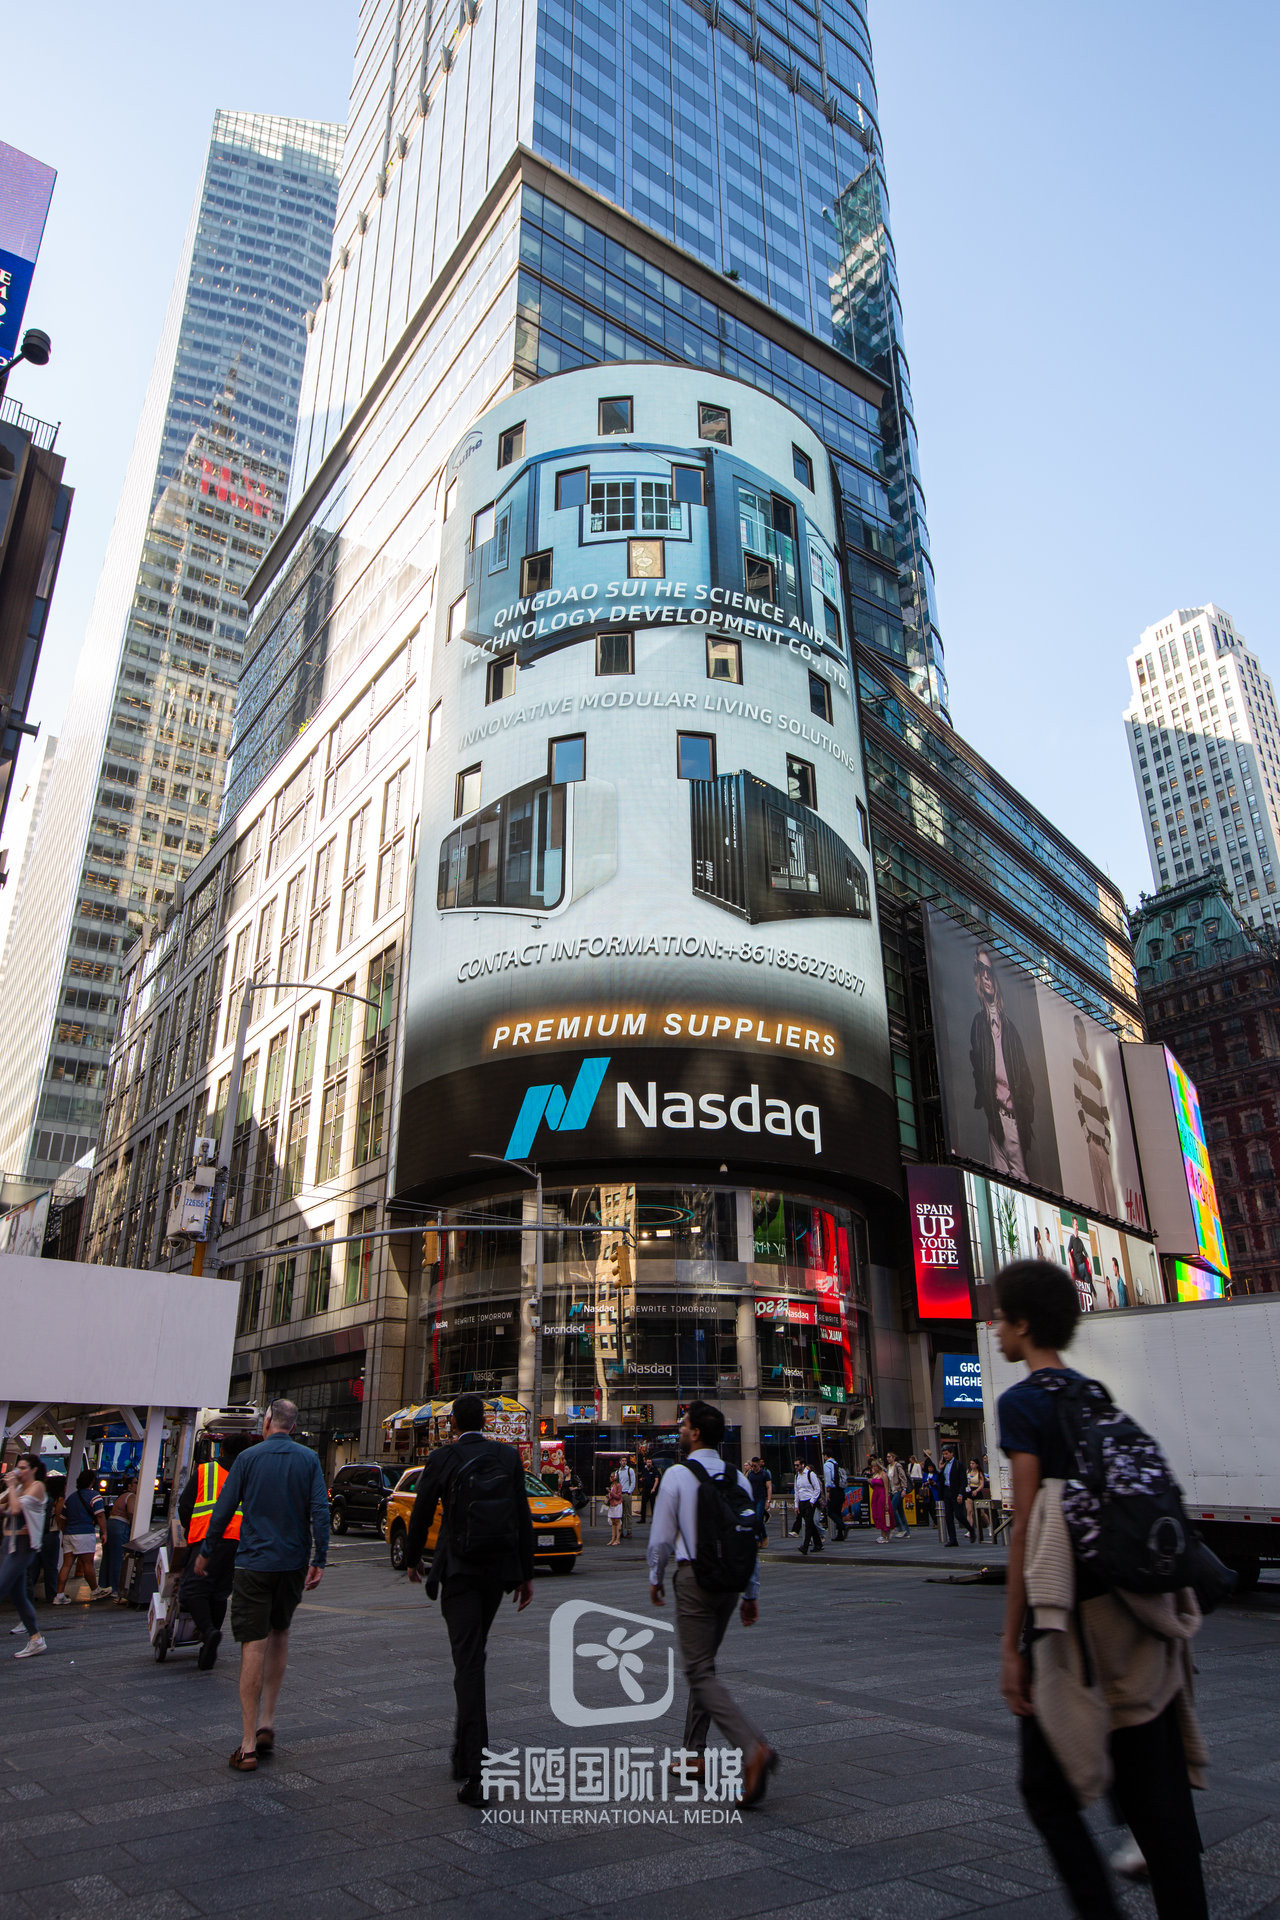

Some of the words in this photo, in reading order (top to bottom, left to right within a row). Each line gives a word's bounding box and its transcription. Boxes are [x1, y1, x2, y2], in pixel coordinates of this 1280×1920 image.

[494, 583, 598, 628] QINGDAO
[605, 581, 647, 597] SUI
[655, 581, 687, 598] HE
[694, 584, 785, 624] SCIENCE
[788, 615, 824, 647] AND
[463, 606, 603, 669] TECHNOLOGY
[609, 605, 784, 646] DEVELOPMENT
[459, 696, 574, 751] INNOVATIVE
[579, 691, 697, 710] MODULAR
[704, 694, 773, 725] LIVING
[777, 713, 855, 773] SOLUTIONS
[457, 943, 548, 983] CONTACT
[492, 1013, 647, 1050] PREMIUM
[663, 1013, 836, 1057] SUPPLIERS
[616, 1081, 822, 1155] Nasdaq
[915, 1203, 953, 1215] SPAIN
[917, 1215, 954, 1237] UP
[919, 1238, 957, 1249] YOUR
[920, 1249, 959, 1265] LIFE
[583, 1304, 615, 1314] Nasdaq
[630, 1305, 667, 1313] REWRITE
[671, 1305, 718, 1314] TOMORROW
[785, 1309, 809, 1321] Nasdaq
[628, 1362, 673, 1376] Nasdaq
